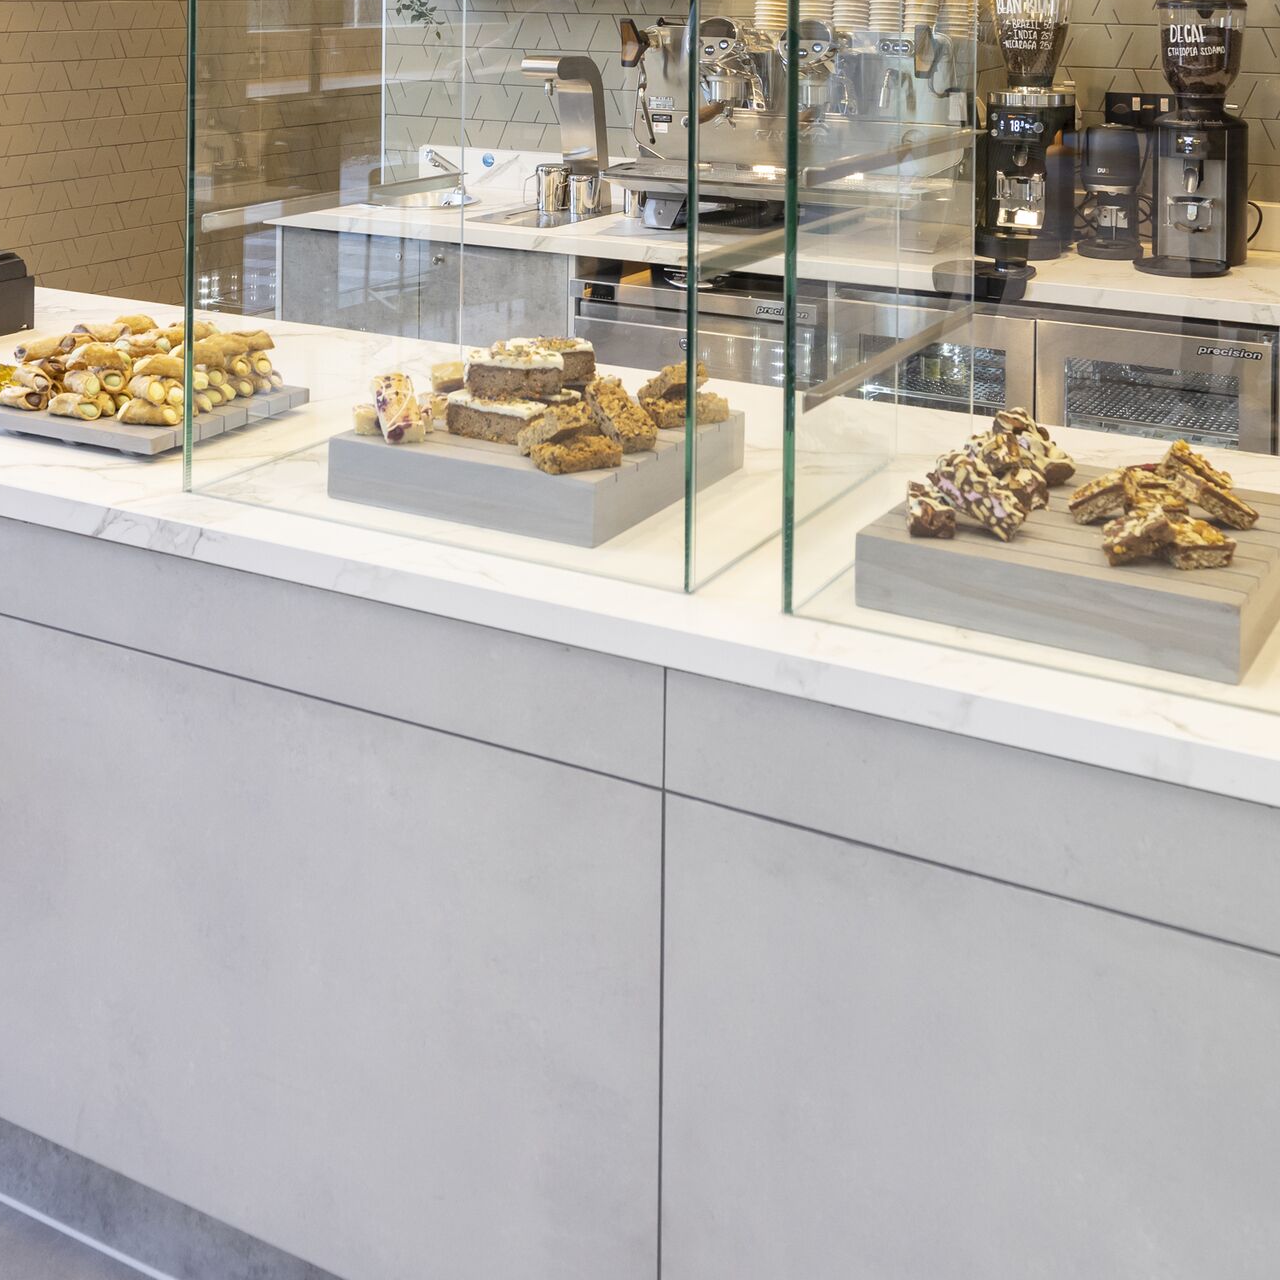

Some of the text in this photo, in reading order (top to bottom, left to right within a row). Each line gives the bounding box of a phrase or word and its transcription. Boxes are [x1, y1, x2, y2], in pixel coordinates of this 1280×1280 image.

[1169, 24, 1207, 43] DECAF
[1200, 46, 1226, 56] SIDAMO
[756, 306, 809, 319] precion
[1197, 345, 1263, 360] precision
